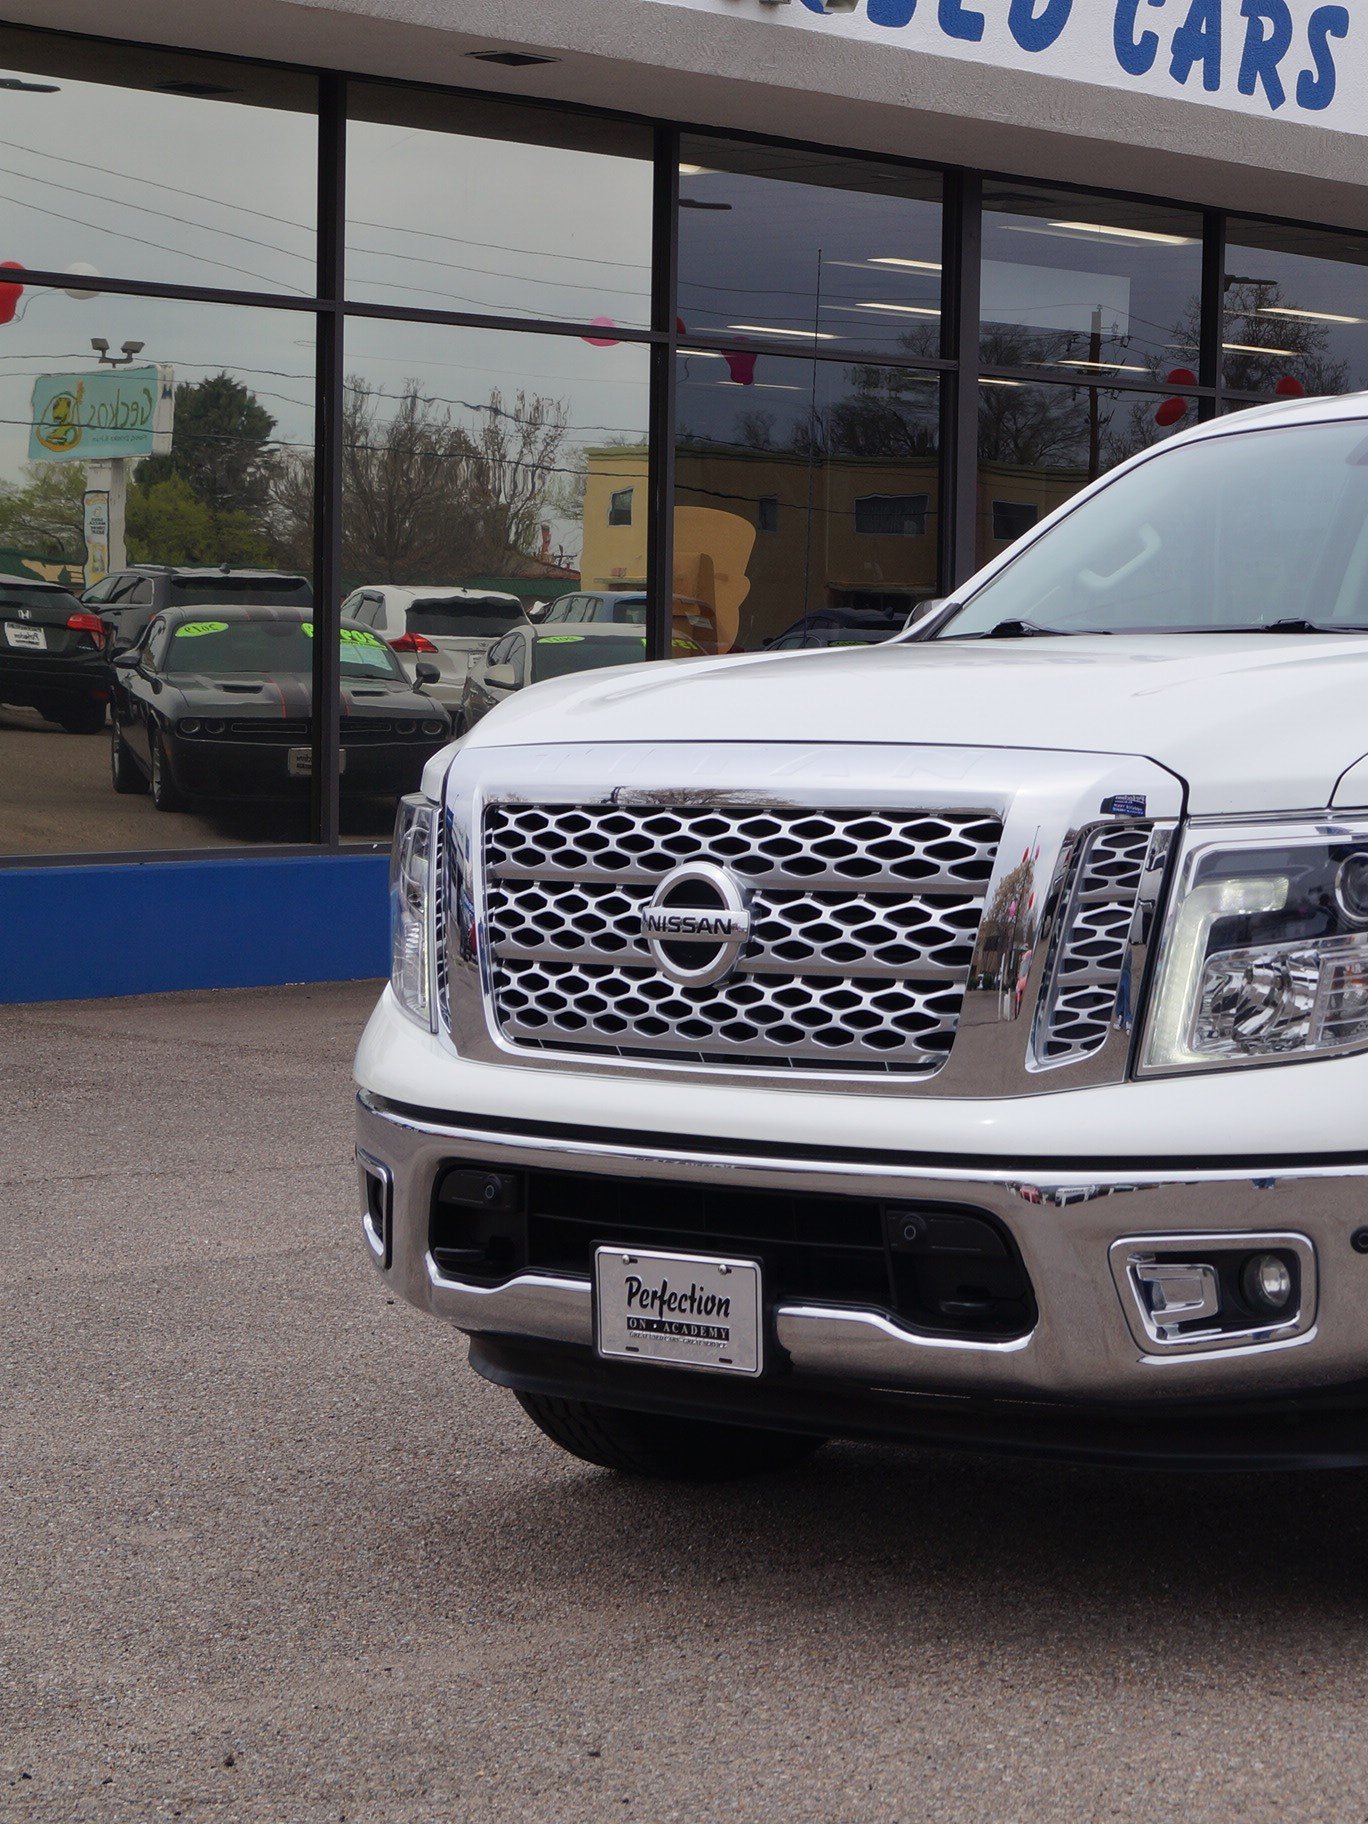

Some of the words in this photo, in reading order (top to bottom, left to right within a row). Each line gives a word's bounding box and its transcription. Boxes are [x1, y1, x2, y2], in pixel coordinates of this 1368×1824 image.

[1112, 0, 1349, 112] CARS
[649, 915, 731, 935] NISSAN
[625, 1276, 730, 1320] Perfection
[629, 1317, 647, 1330] ON
[663, 1321, 729, 1340] ACADEMY
